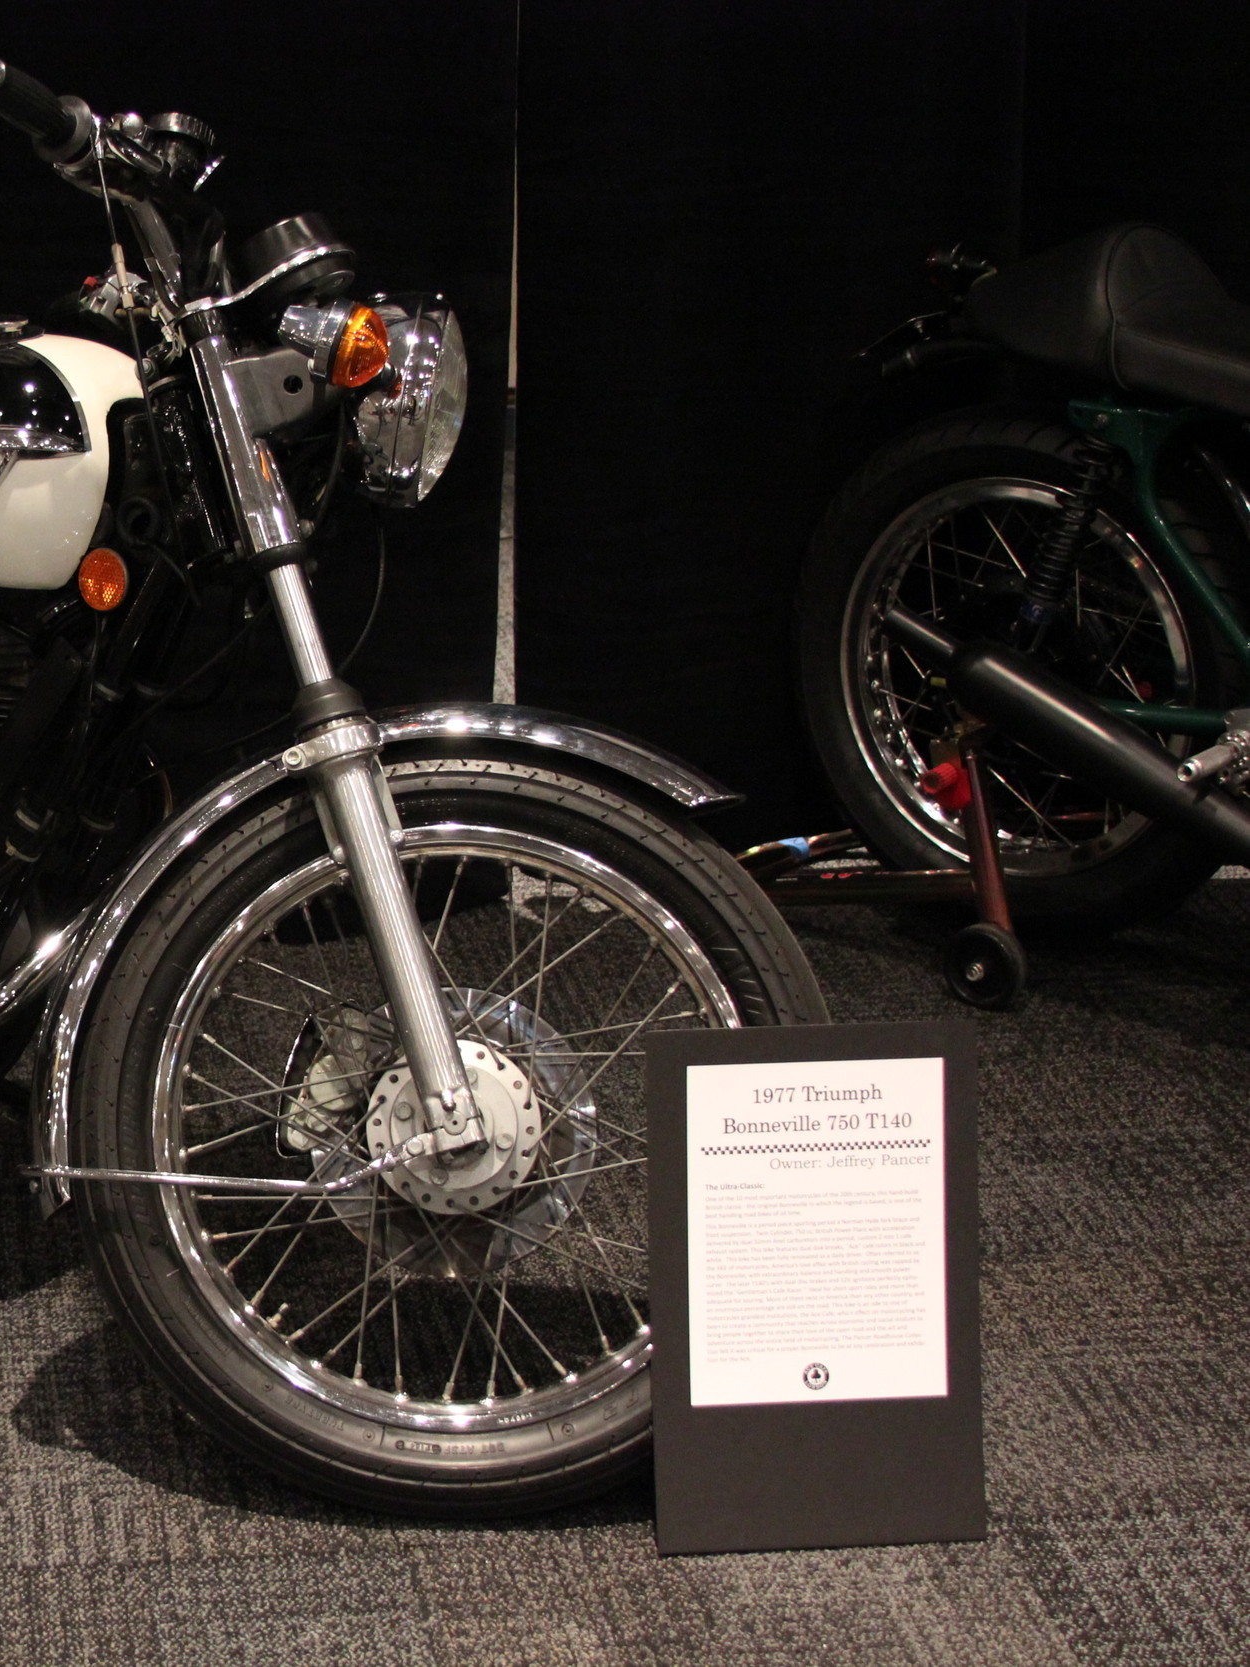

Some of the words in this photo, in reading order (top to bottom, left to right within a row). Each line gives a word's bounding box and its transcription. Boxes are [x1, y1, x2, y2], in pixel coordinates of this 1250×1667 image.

[753, 1088, 795, 1104] 1977
[801, 1084, 883, 1104] Triumph
[723, 1115, 821, 1134] Bonneville
[827, 1114, 860, 1131] 750
[866, 1112, 912, 1130] T140
[770, 1157, 822, 1170] Owner:
[827, 1154, 876, 1170] Jeffrey
[881, 1153, 931, 1167] Pancer
